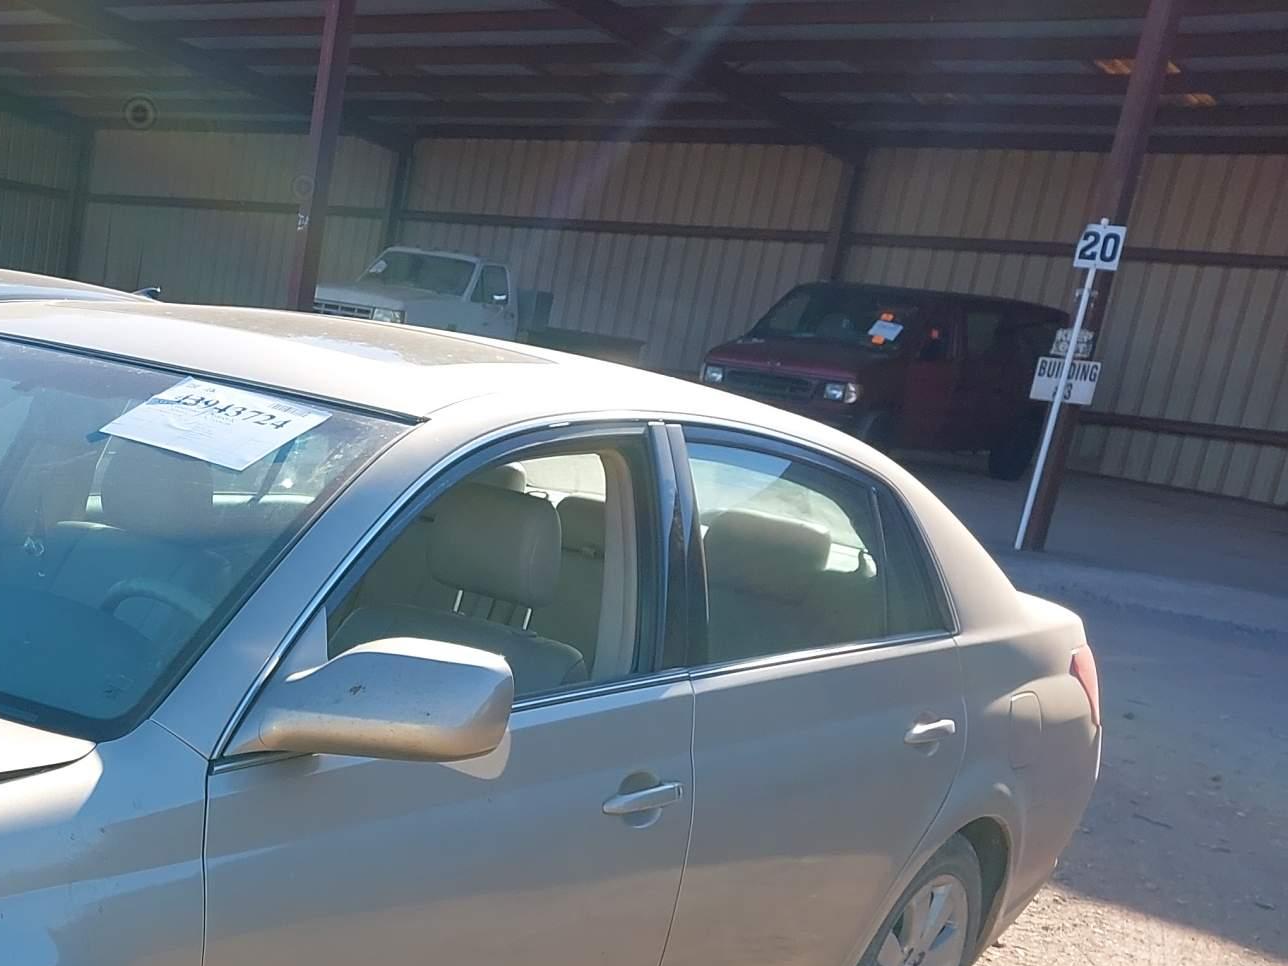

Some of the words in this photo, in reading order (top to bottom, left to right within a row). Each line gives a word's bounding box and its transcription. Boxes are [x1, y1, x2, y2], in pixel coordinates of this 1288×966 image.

[1078, 231, 1121, 262] 20
[1058, 342, 1088, 353] OT
[1052, 384, 1073, 400] 3
[176, 394, 292, 430] 43943724
